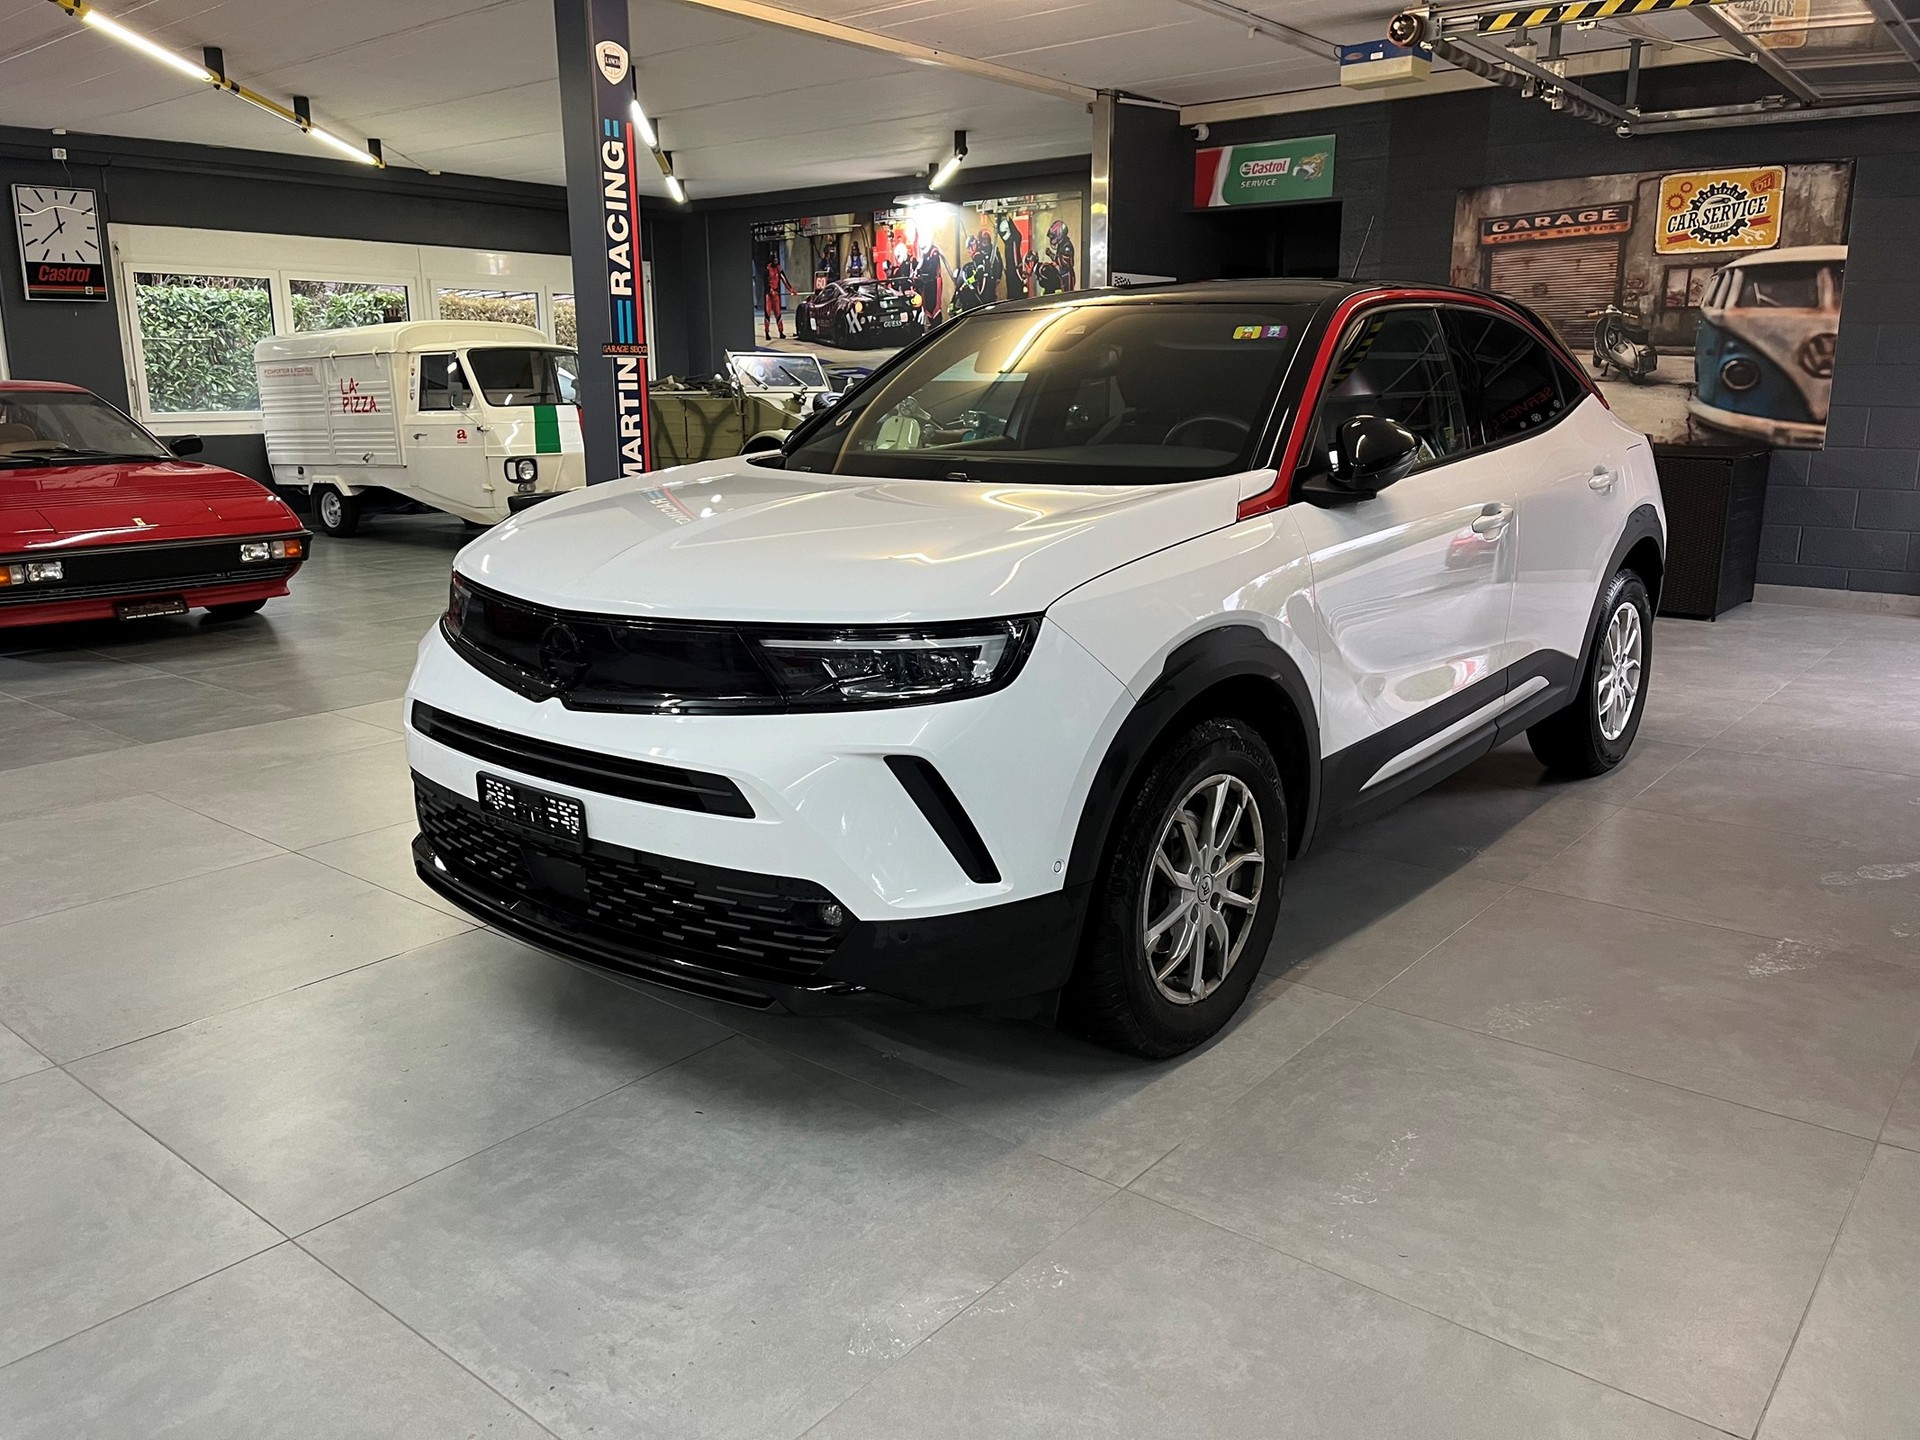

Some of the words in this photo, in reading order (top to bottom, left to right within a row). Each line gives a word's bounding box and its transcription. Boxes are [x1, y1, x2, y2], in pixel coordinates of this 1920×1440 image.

[1252, 160, 1286, 175] Castrol
[1240, 178, 1277, 188] SERVICE
[1713, 187, 1739, 198] REPAIR
[602, 140, 632, 295] RACING
[1492, 208, 1620, 233] GARAGE
[1667, 211, 1698, 233] CAR
[1702, 196, 1768, 226] SERVICE
[38, 265, 91, 283] Castrol
[883, 320, 902, 328] GUESS
[602, 345, 629, 353] GARAGE
